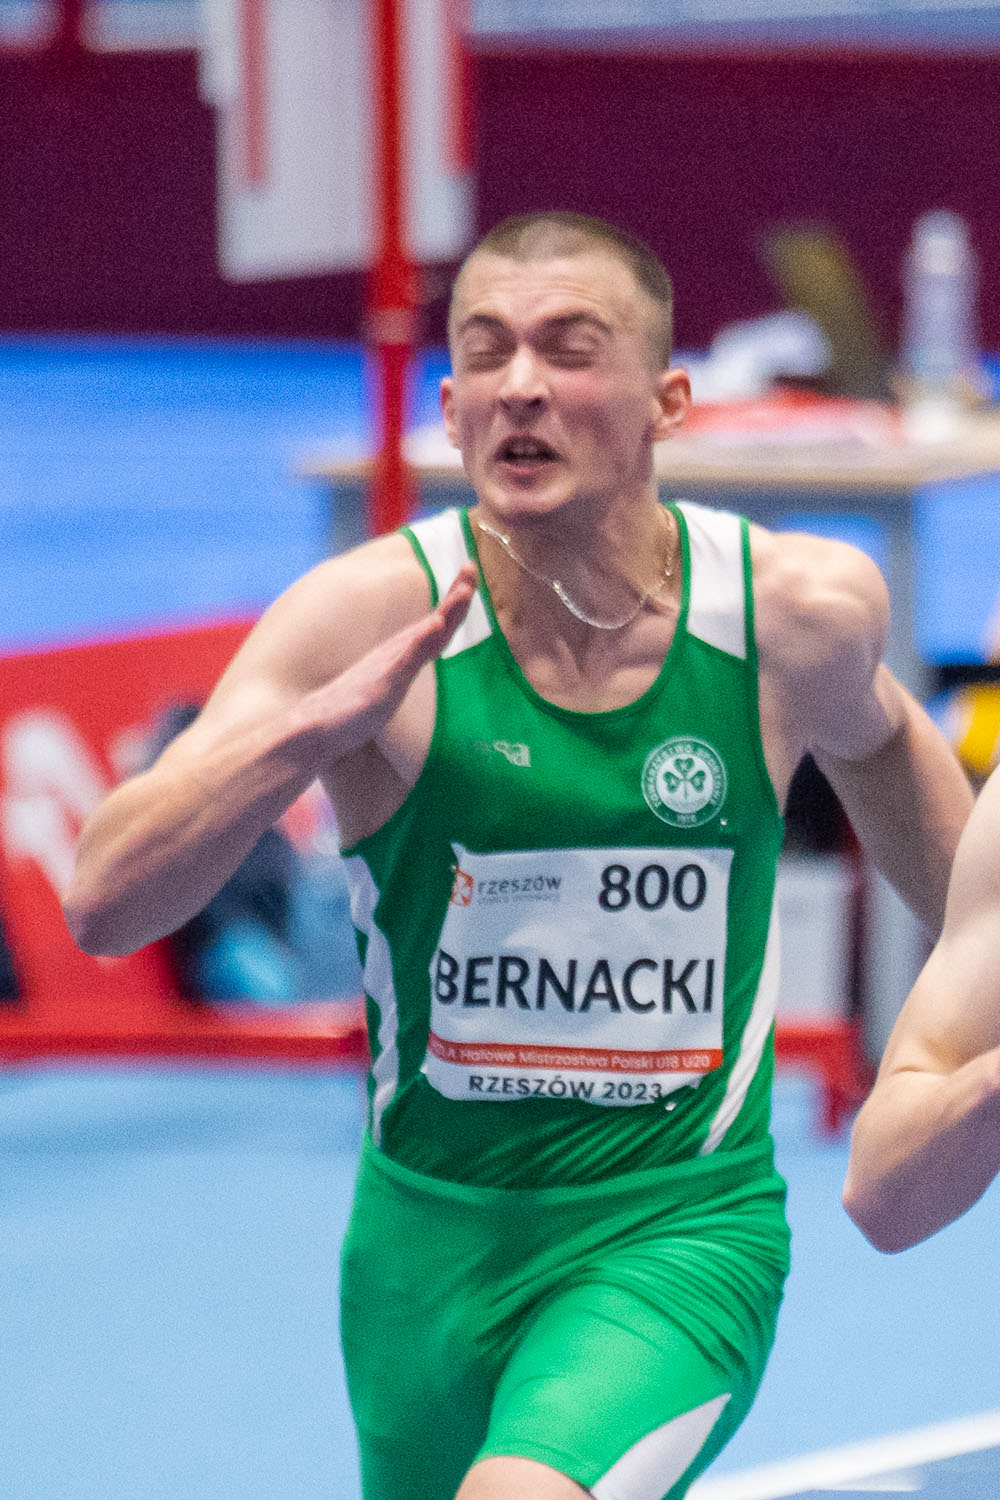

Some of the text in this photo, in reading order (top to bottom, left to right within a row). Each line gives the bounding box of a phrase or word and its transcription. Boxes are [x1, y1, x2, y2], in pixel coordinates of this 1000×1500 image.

[478, 875, 561, 895] rzeszów
[600, 864, 707, 912] 800
[435, 949, 715, 1014] BERNACKI
[460, 1049, 515, 1062] Halowe
[519, 1051, 607, 1068] Mistrzostwa
[611, 1055, 653, 1070] Polski
[656, 1056, 679, 1069] U18
[682, 1056, 710, 1068] U20
[469, 1074, 662, 1100] RZESZÓW 2023
